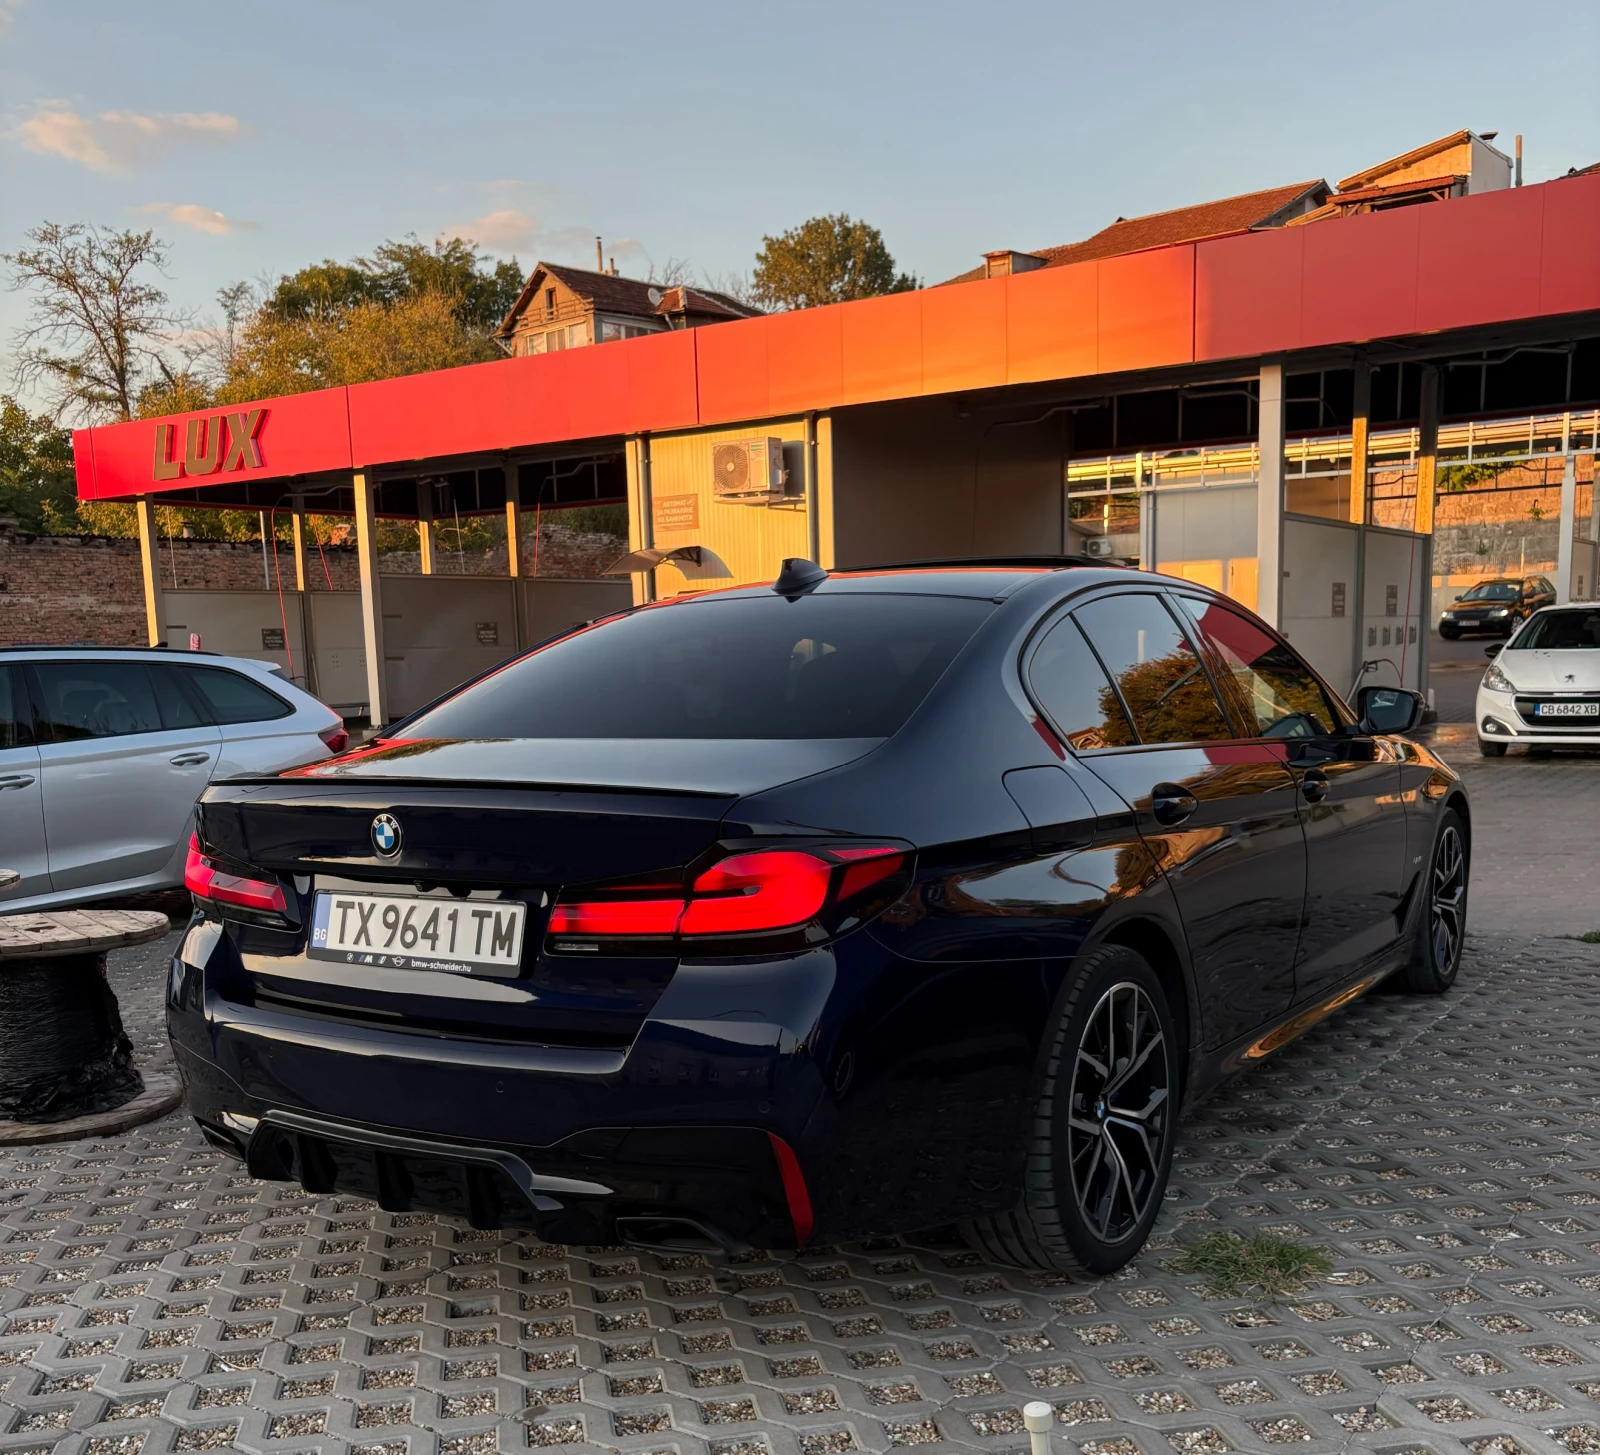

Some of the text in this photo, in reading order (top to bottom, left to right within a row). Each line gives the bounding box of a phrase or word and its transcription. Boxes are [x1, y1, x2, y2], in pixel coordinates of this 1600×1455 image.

[153, 409, 268, 480] LUX
[1541, 705, 1597, 714] CB 6842 XB
[314, 927, 327, 941] BG
[335, 900, 517, 958] TX 9641 TM
[411, 958, 472, 973] bmw-schneider.hu
